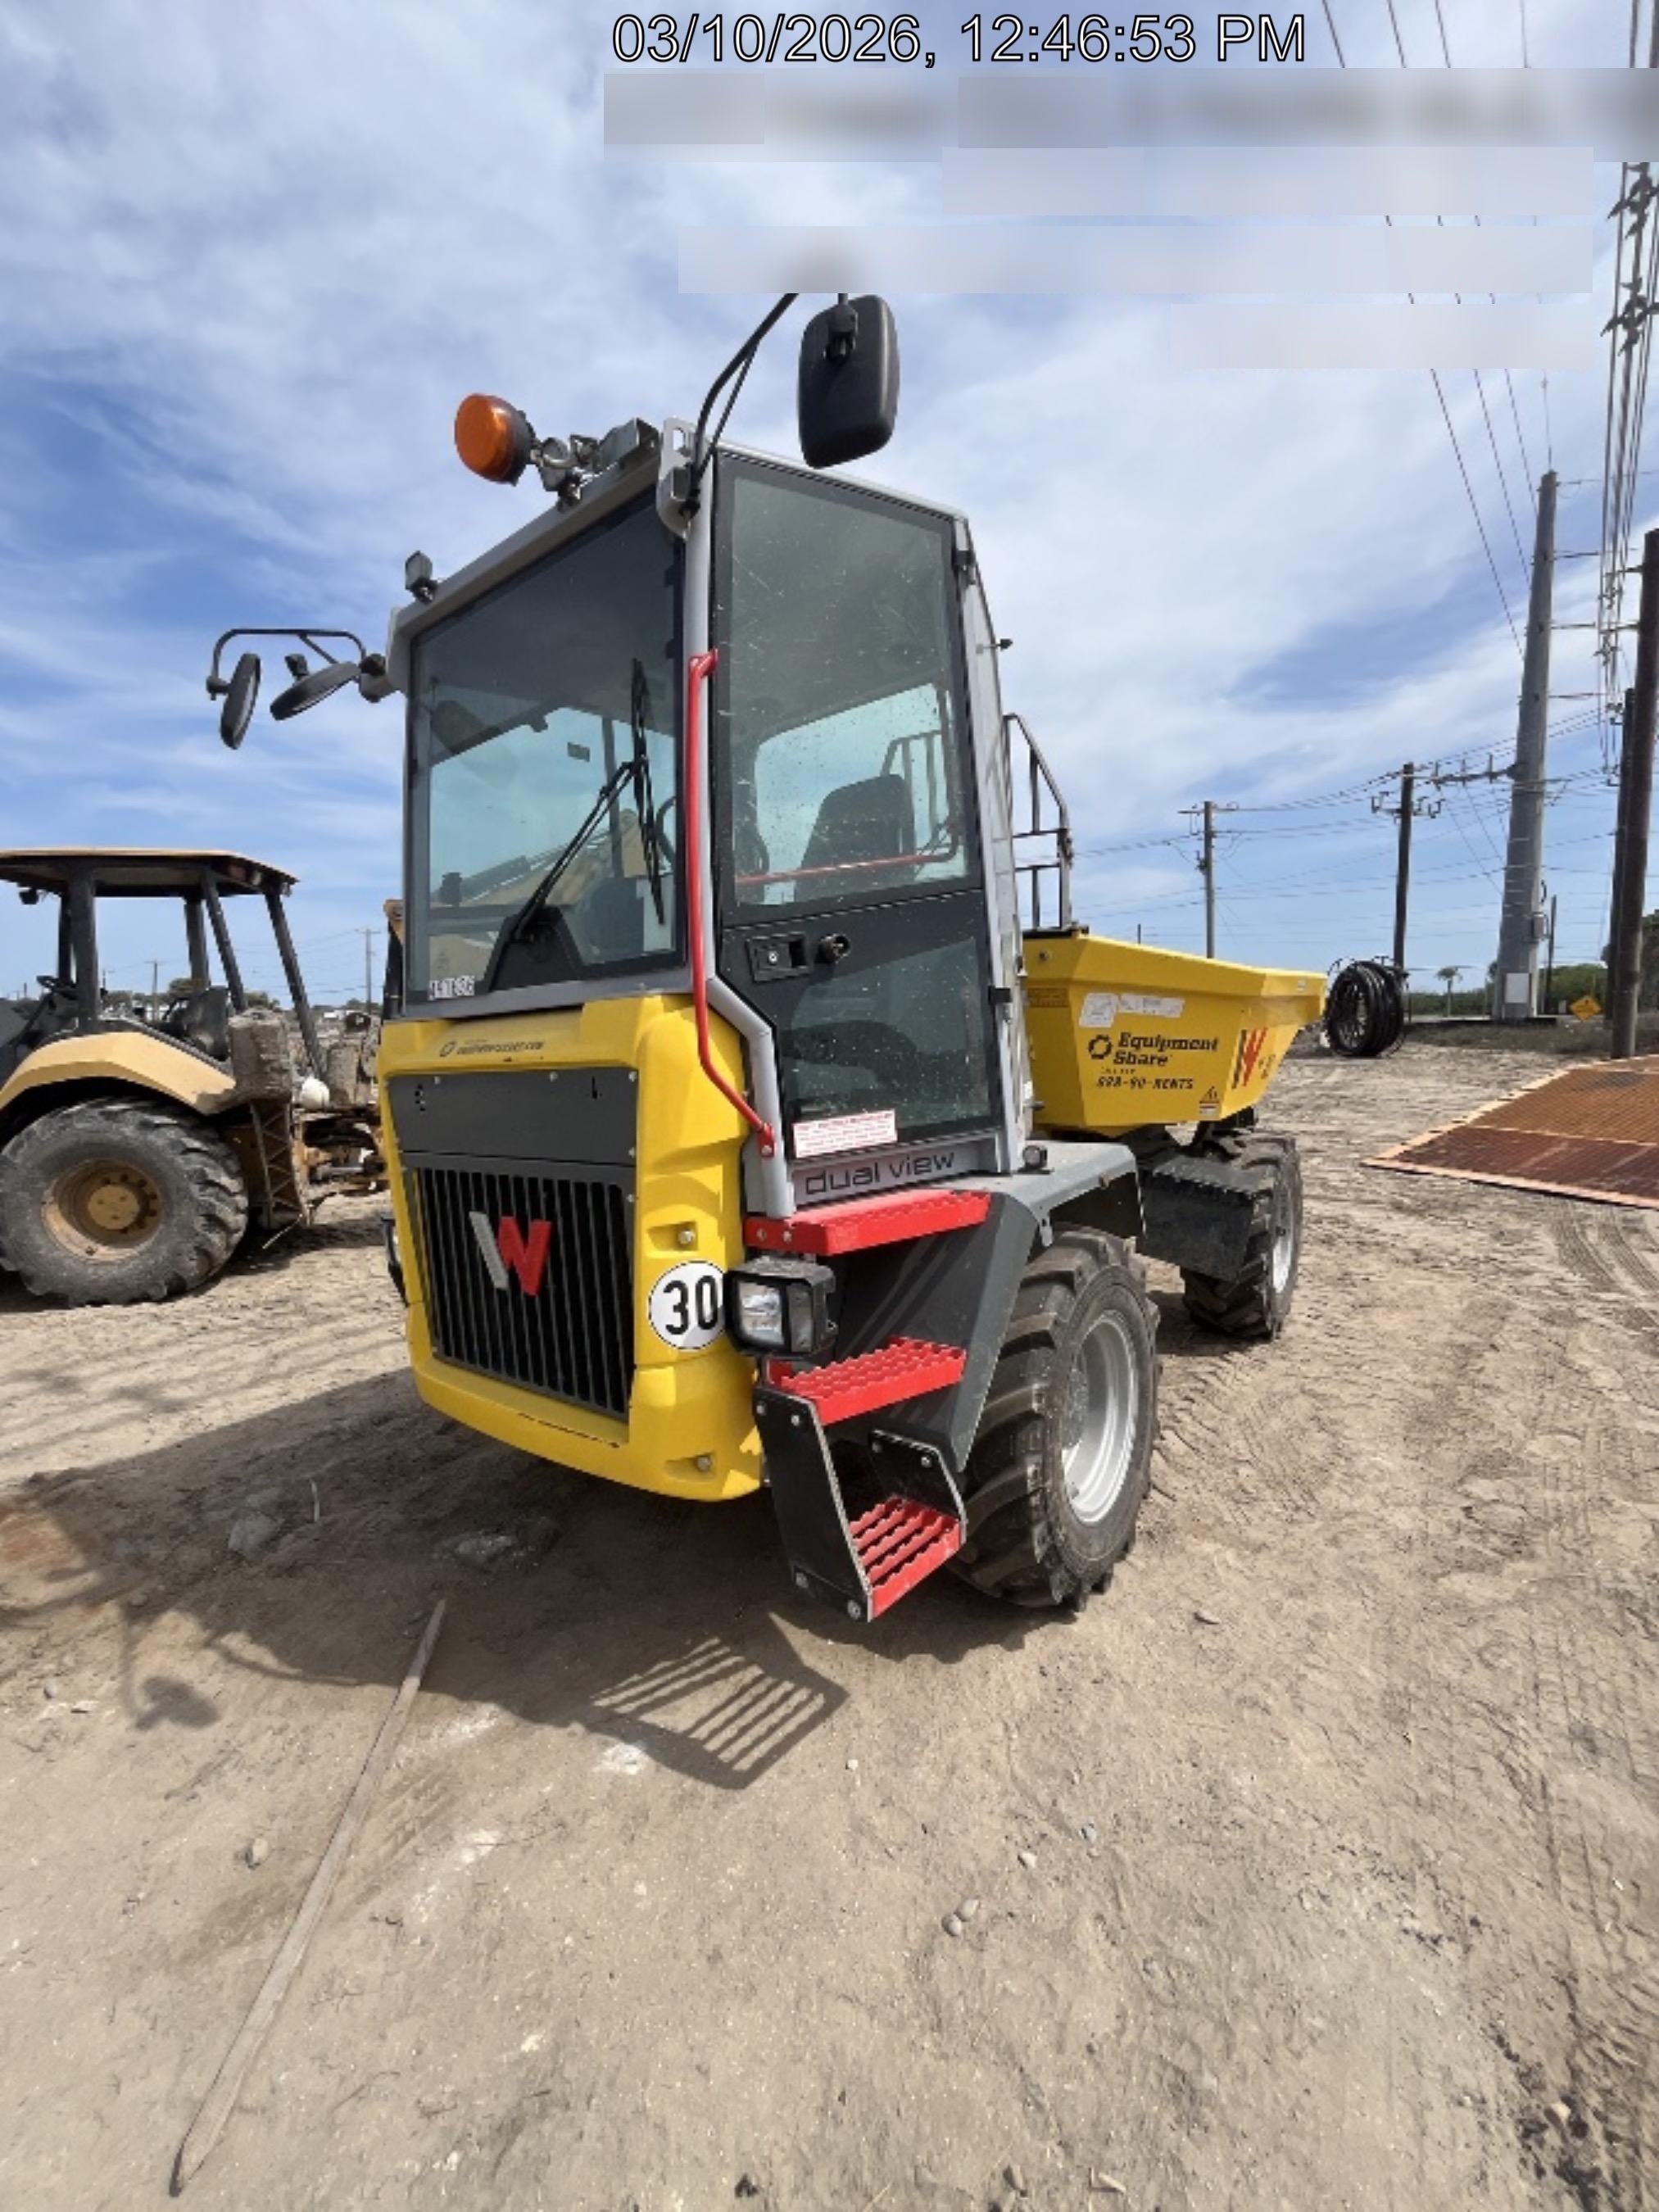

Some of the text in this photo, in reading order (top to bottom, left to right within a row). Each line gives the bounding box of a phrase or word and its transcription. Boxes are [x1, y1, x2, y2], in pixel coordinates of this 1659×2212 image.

[1118, 1032, 1218, 1052] Equipment
[1113, 1050, 1168, 1067] Share
[806, 1152, 954, 1194] dual view
[663, 1276, 718, 1335] 30
